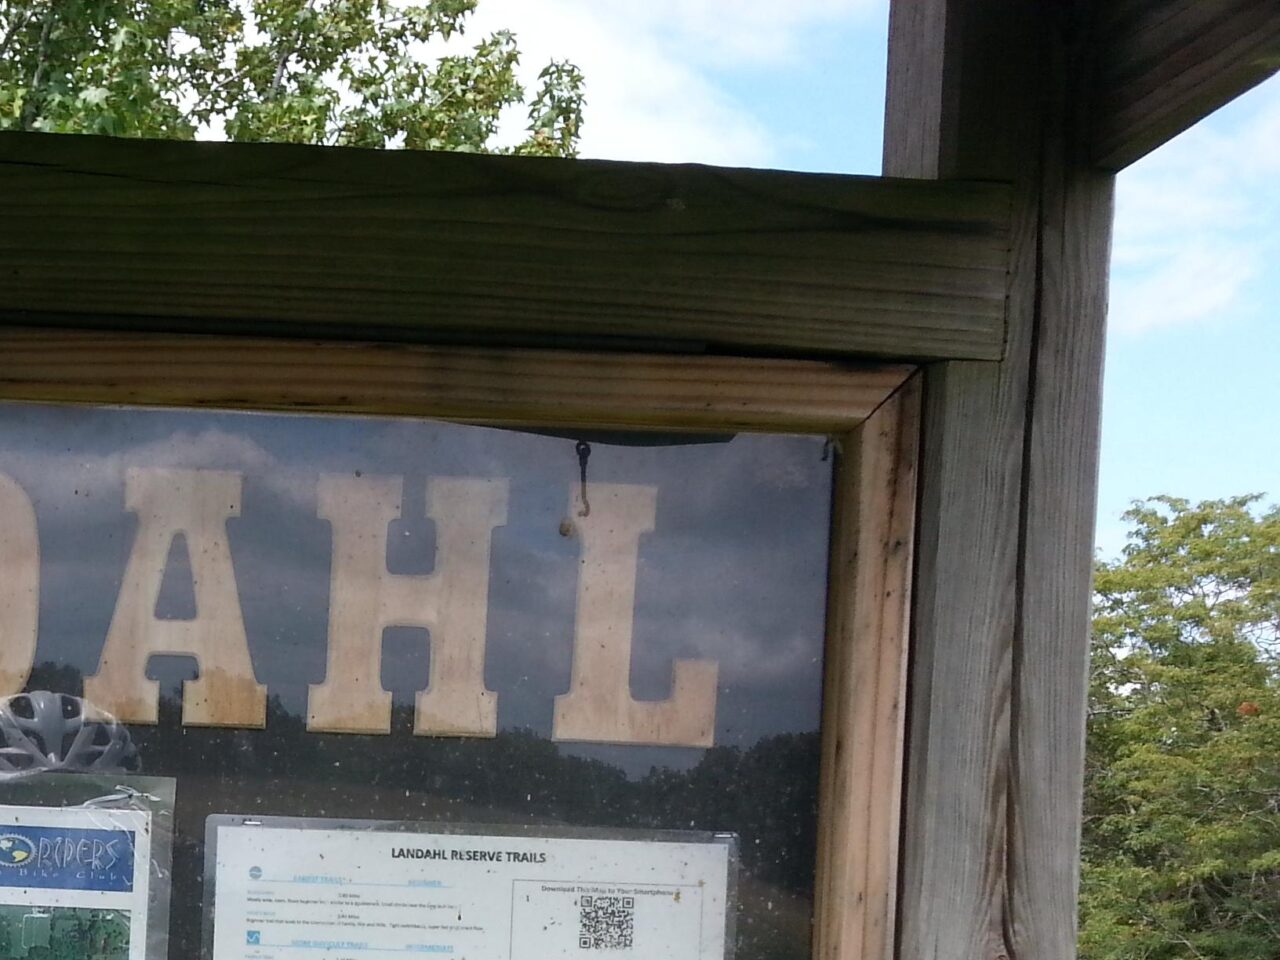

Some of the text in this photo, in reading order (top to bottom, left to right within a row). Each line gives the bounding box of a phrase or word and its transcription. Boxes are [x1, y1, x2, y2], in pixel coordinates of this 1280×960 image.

[37, 836, 119, 871] RIDERS
[391, 847, 547, 864] LANDAHL RESERVE TRAILS
